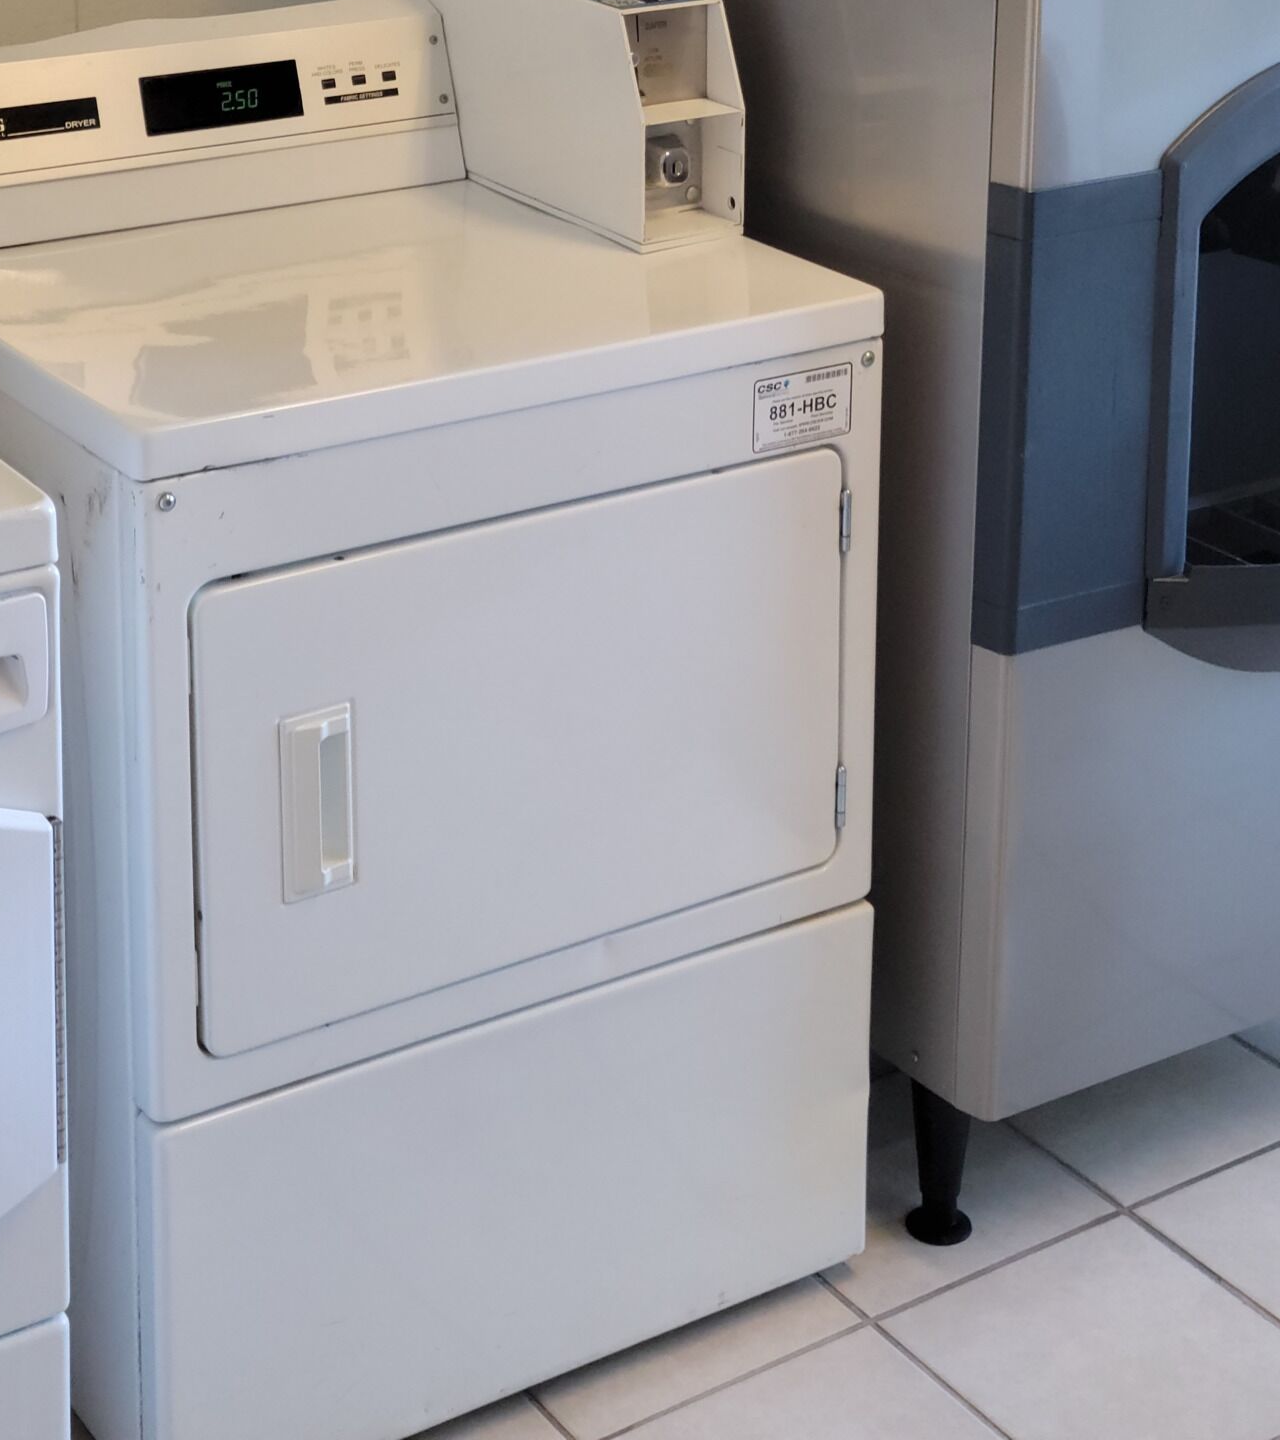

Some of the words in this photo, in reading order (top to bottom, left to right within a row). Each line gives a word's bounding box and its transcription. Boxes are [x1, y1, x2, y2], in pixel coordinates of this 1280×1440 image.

[221, 88, 258, 112] 2.50
[65, 118, 96, 130] DRYER
[758, 381, 782, 394] CSC
[769, 393, 837, 421] 881-HBC
